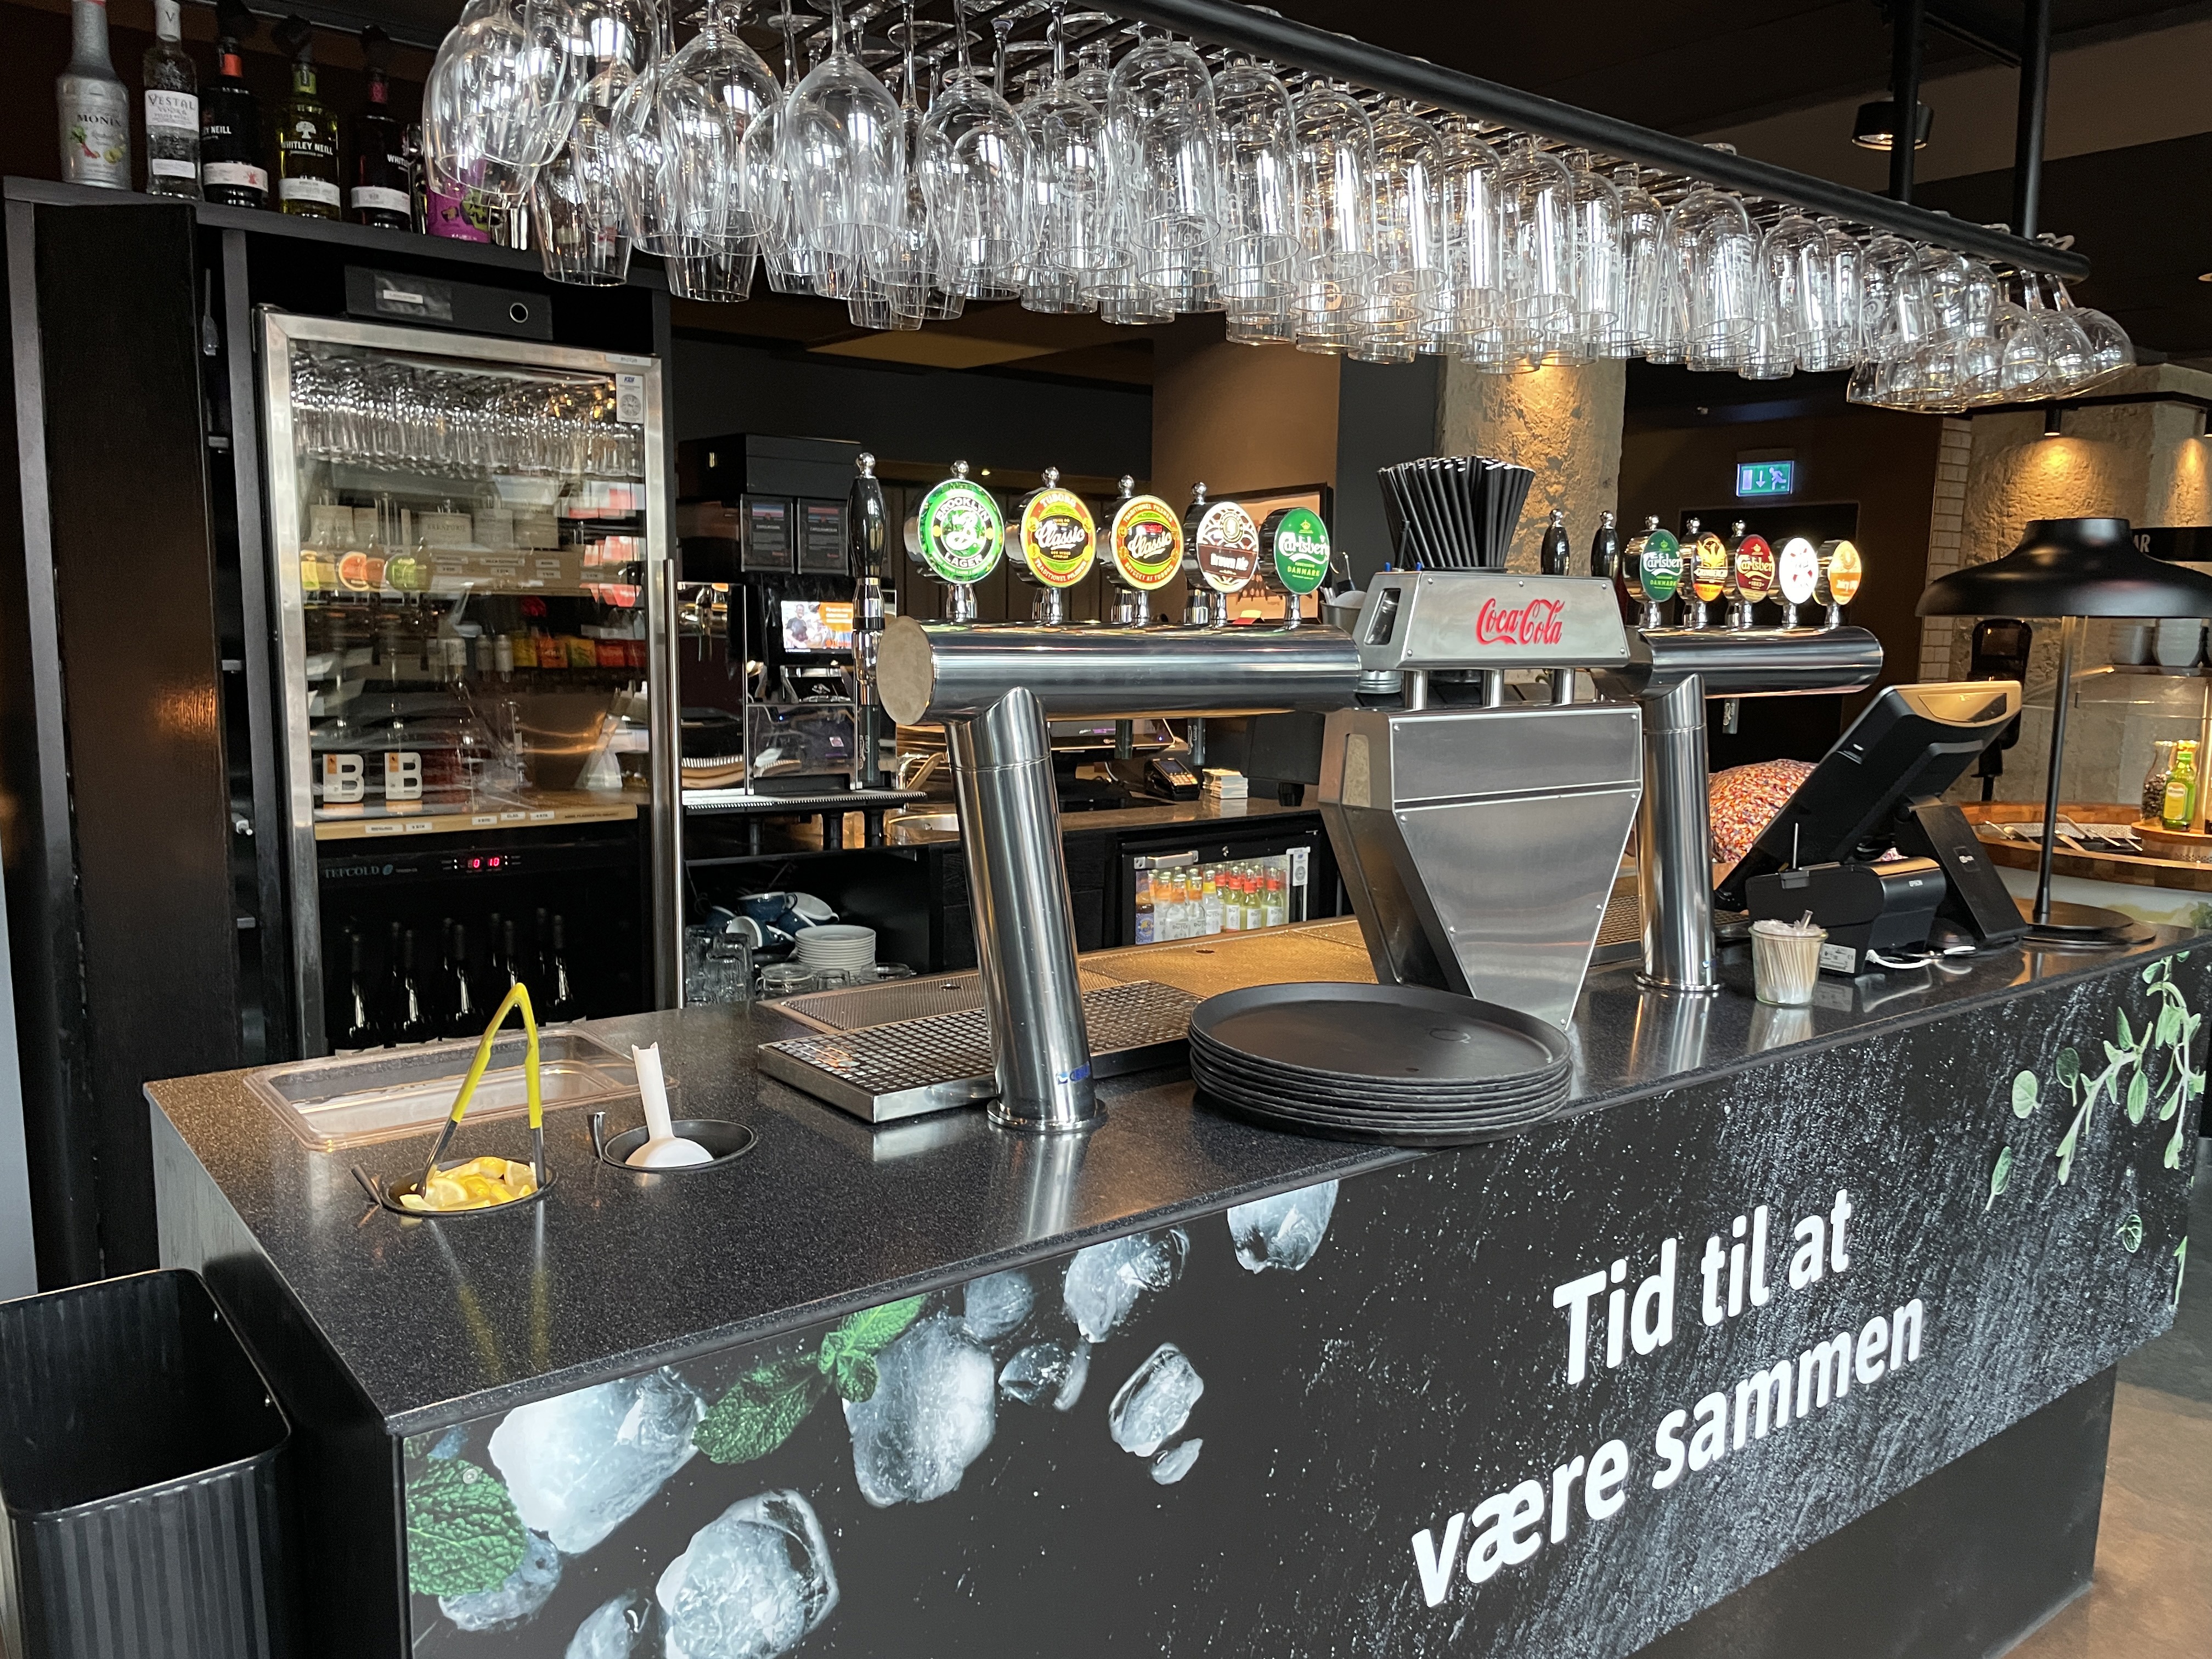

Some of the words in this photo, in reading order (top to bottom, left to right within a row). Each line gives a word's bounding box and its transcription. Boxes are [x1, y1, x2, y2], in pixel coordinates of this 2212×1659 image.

[147, 94, 196, 110] VESTAL
[211, 125, 232, 134] NEILL
[314, 143, 334, 156] NEILL
[935, 497, 990, 522] BROOKLYN
[1039, 493, 1077, 509] TUBORG
[1034, 519, 1086, 549] Classic
[1127, 531, 1172, 558] Classic
[944, 552, 984, 568] LAGER
[1643, 551, 1684, 573] Carlsber
[1736, 554, 1773, 574] Carlsber
[1287, 566, 1320, 577] DANMARK
[1476, 597, 1565, 645] Coca-Cola
[1554, 1239, 1677, 1385] Tid
[1701, 1205, 1770, 1326] til
[1790, 1189, 1852, 1290] at
[1412, 1440, 1629, 1607] være
[1652, 1299, 1923, 1489] sammen
